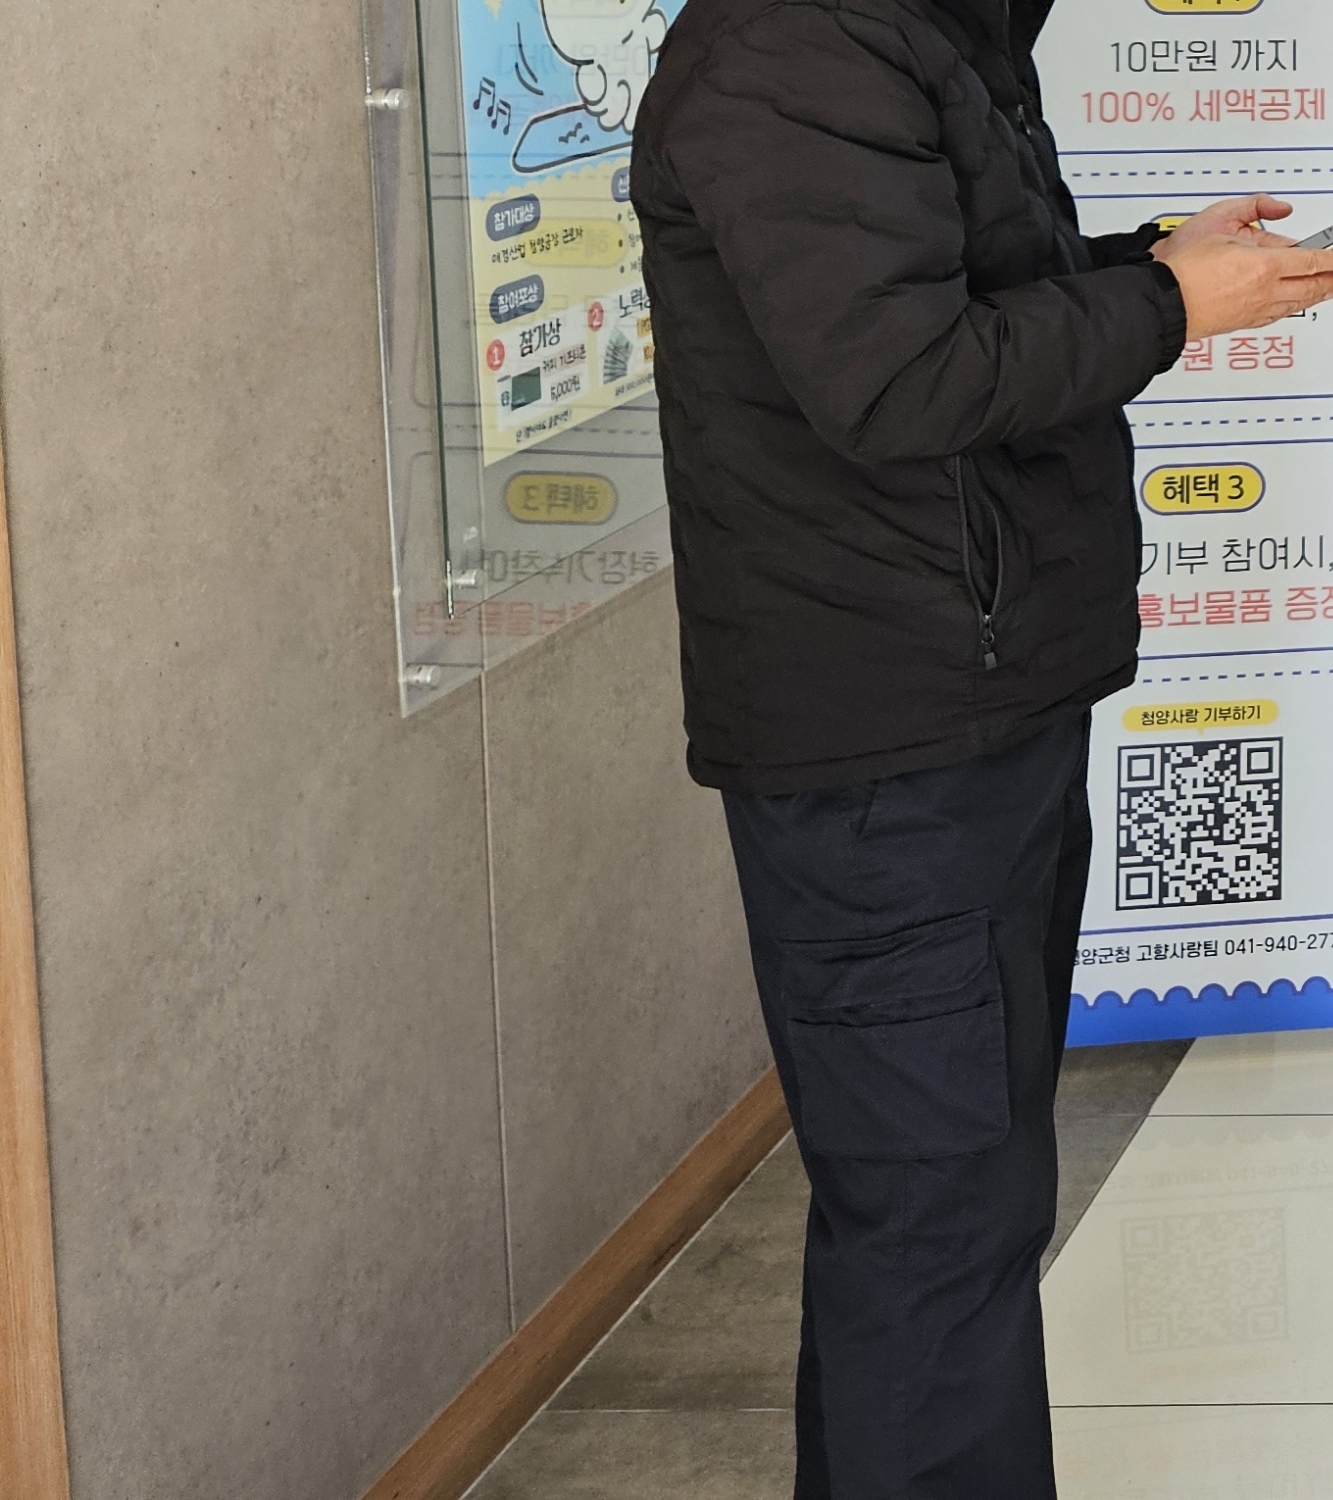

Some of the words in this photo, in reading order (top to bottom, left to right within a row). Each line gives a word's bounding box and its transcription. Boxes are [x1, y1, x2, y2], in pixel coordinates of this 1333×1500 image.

[1110, 40, 1218, 73] 10만원
[1231, 39, 1298, 72] 까지
[1081, 91, 1175, 123] 100%
[1189, 88, 1326, 122] 세액공제
[494, 203, 536, 232] 참가대상
[497, 285, 540, 312] 참여포상
[519, 318, 562, 357] 참가상
[1227, 334, 1294, 370] 증정
[1163, 474, 1220, 504] 혜택
[1227, 476, 1245, 500] 3
[1141, 540, 1209, 576] 기부
[1138, 589, 1273, 628] 홍보물품
[1141, 708, 1199, 726] 청양사랑
[1203, 705, 1261, 722] 기부하기
[1136, 940, 1219, 962] 고향사랑팀
